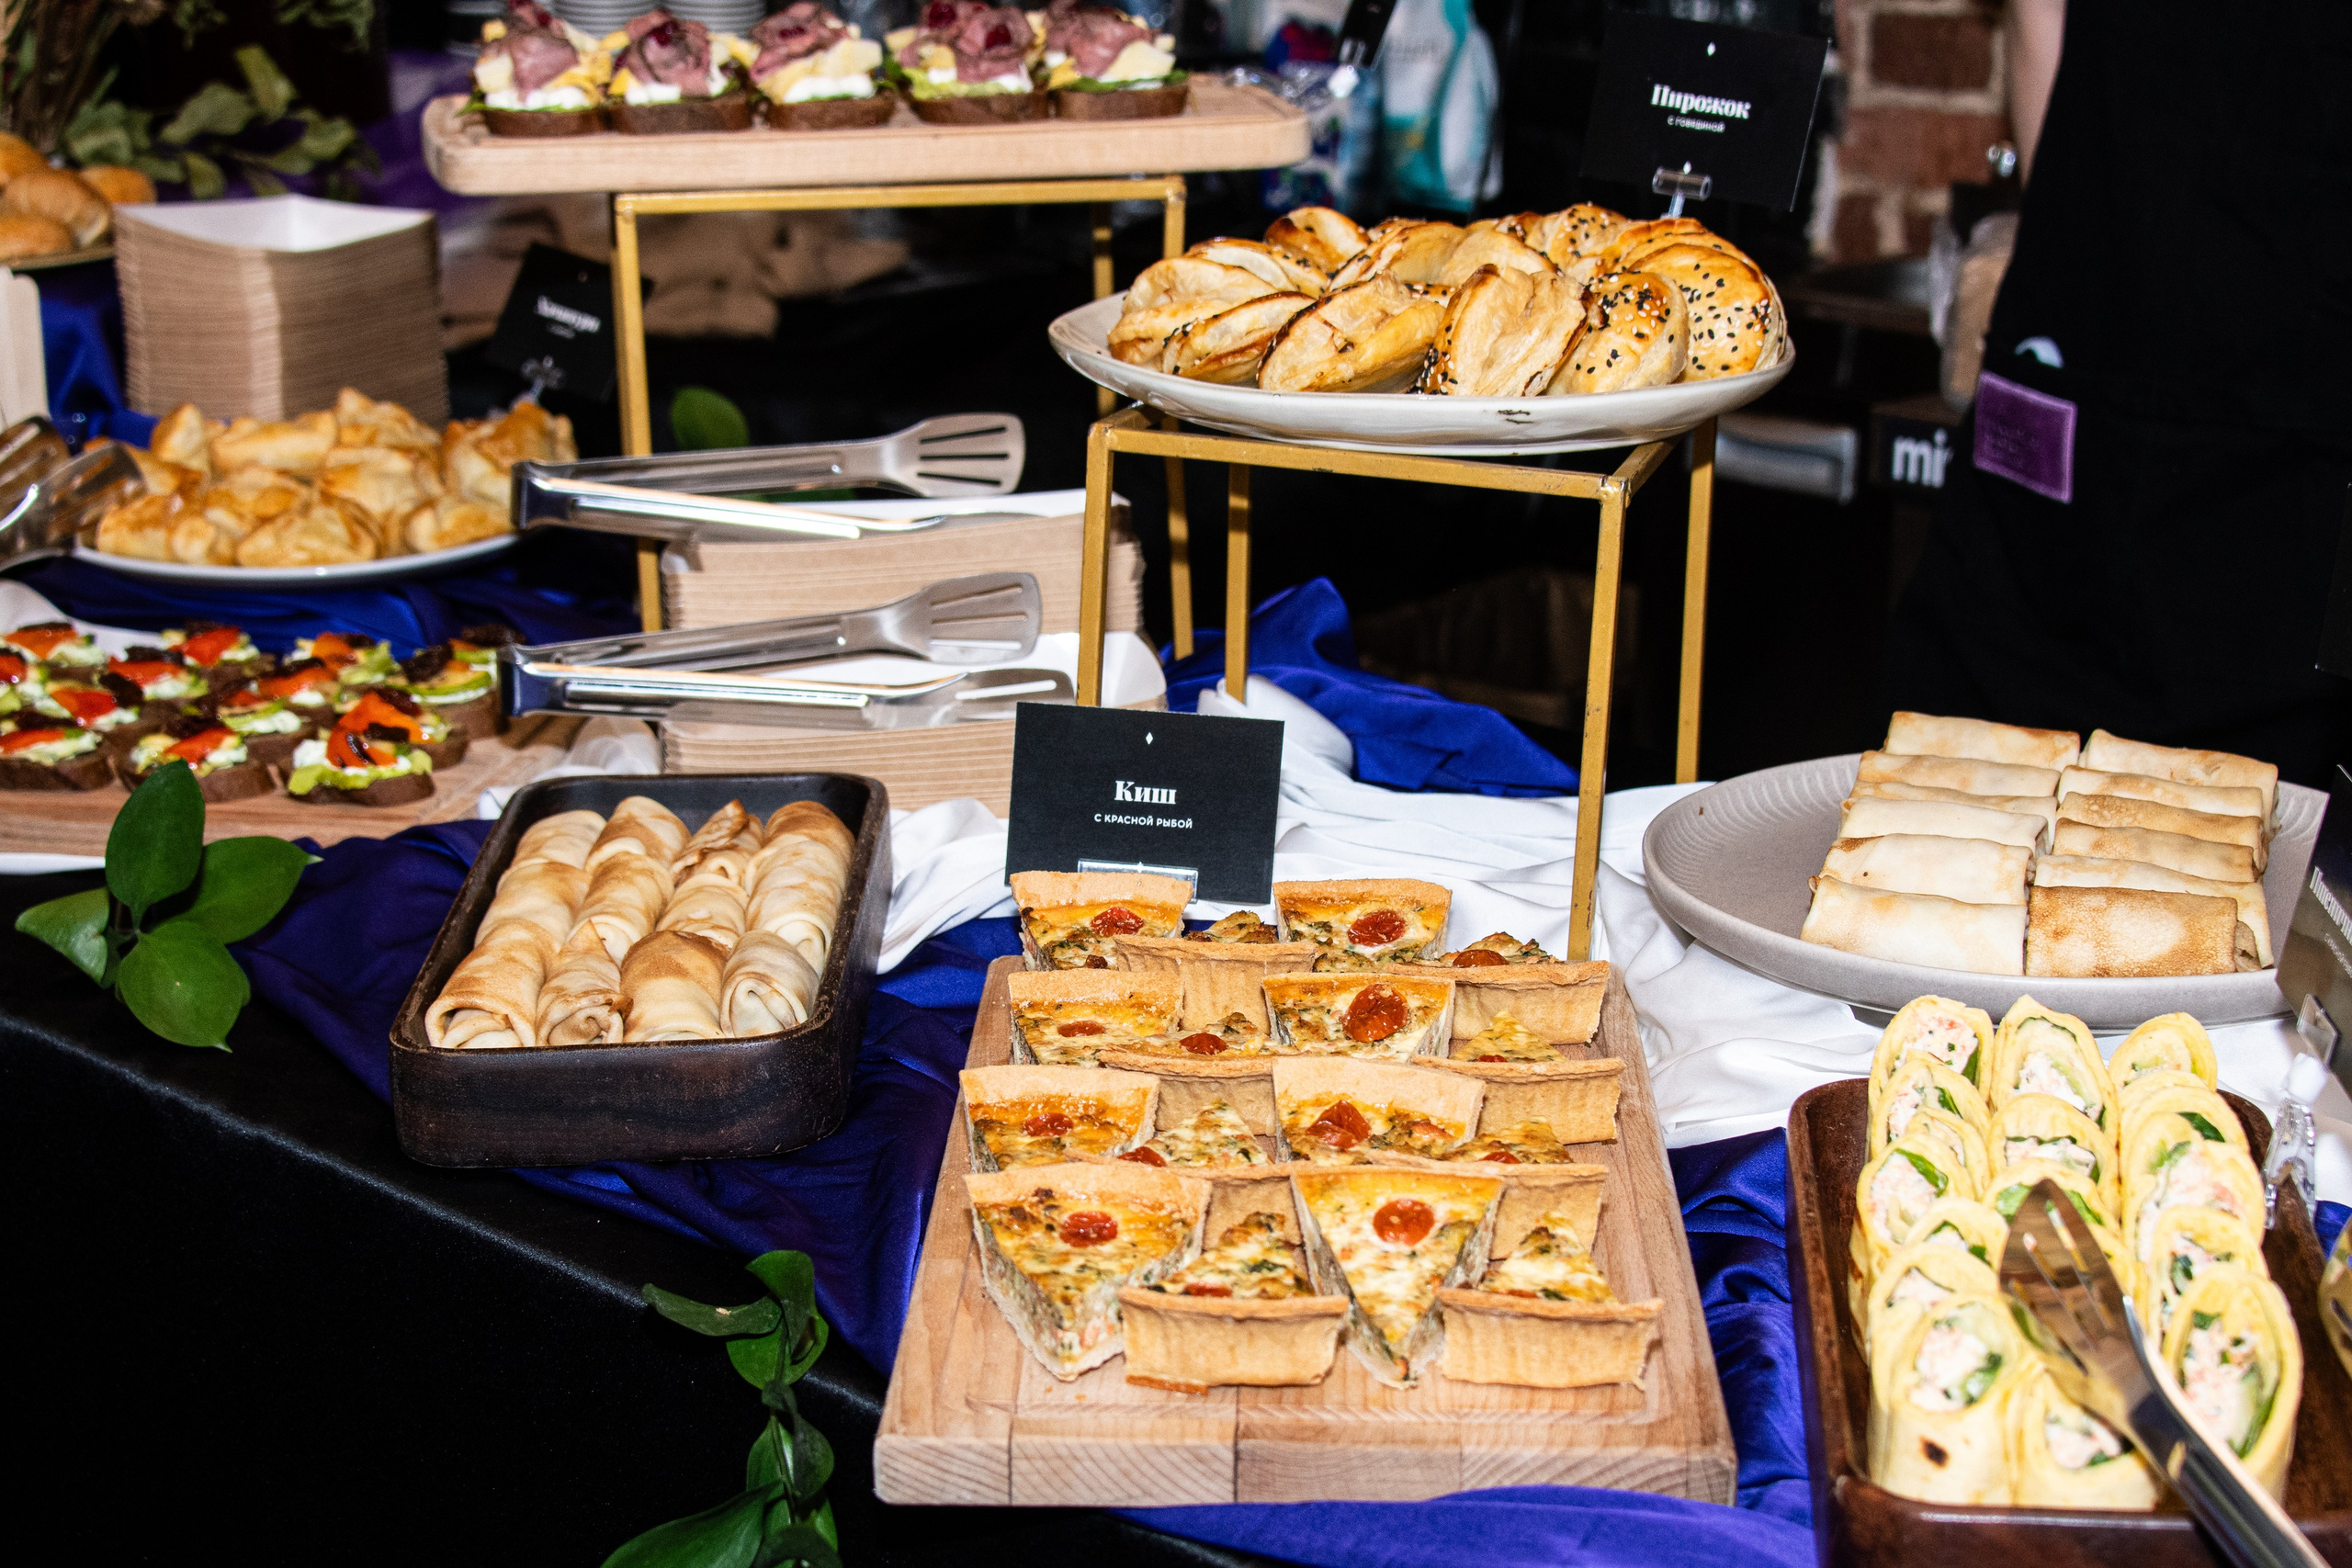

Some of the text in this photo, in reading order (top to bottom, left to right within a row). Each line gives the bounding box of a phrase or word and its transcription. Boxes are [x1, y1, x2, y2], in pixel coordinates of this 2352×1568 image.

[1651, 84, 1751, 119] Пирожок
[1892, 428, 1953, 488] mi
[1114, 780, 1177, 805] Киш
[1093, 813, 1193, 829] С КРАСНОЙ РЫБОЙ
